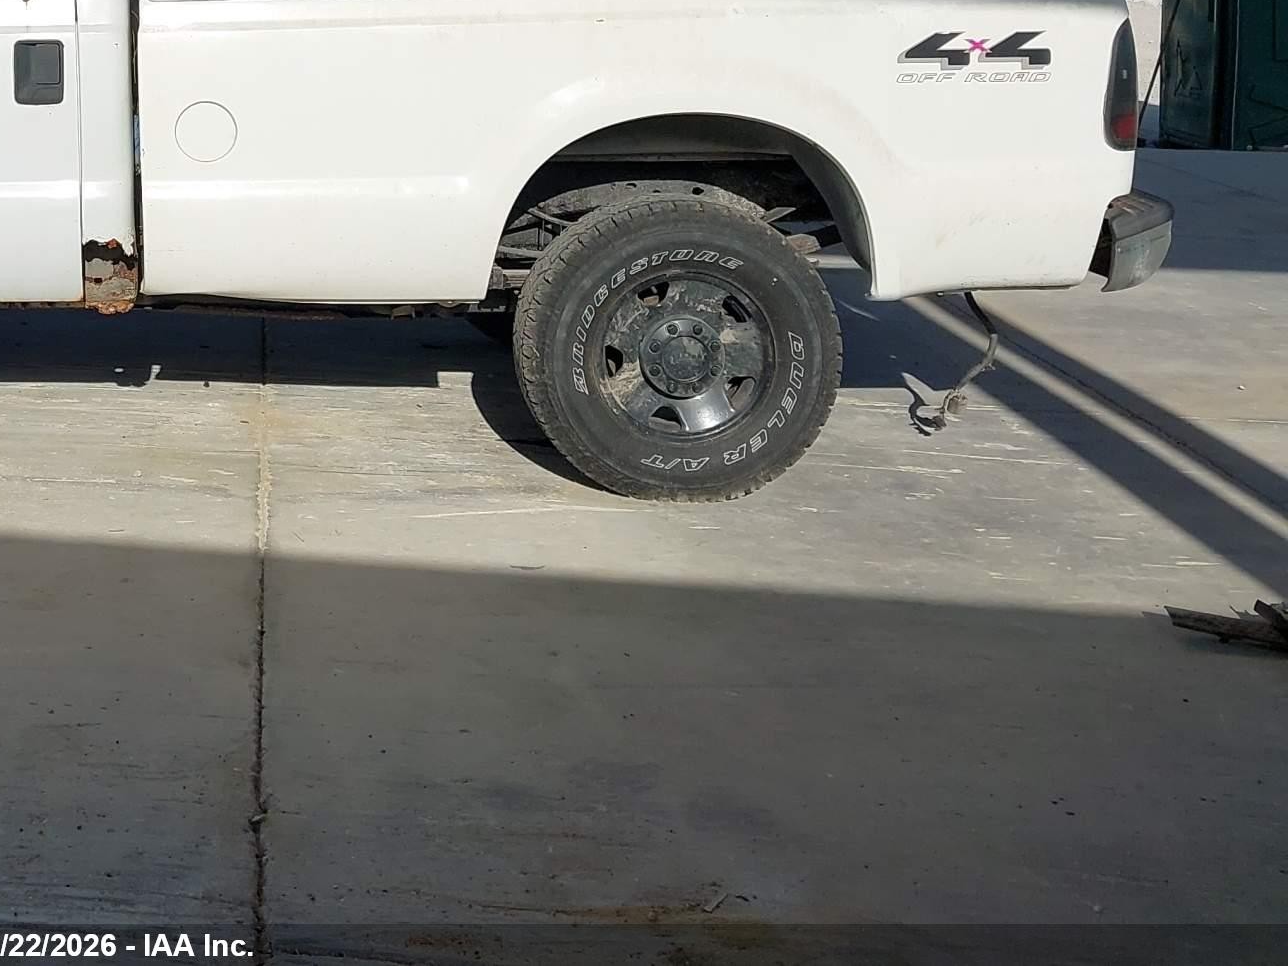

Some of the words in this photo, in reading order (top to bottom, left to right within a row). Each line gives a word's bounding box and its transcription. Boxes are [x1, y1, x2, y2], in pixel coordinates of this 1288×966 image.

[896, 72, 957, 84] OFF
[964, 71, 1052, 83] ROAD
[572, 249, 744, 395] BRIDGESTONE
[723, 331, 805, 466] DUELER
[641, 453, 710, 471] A/T
